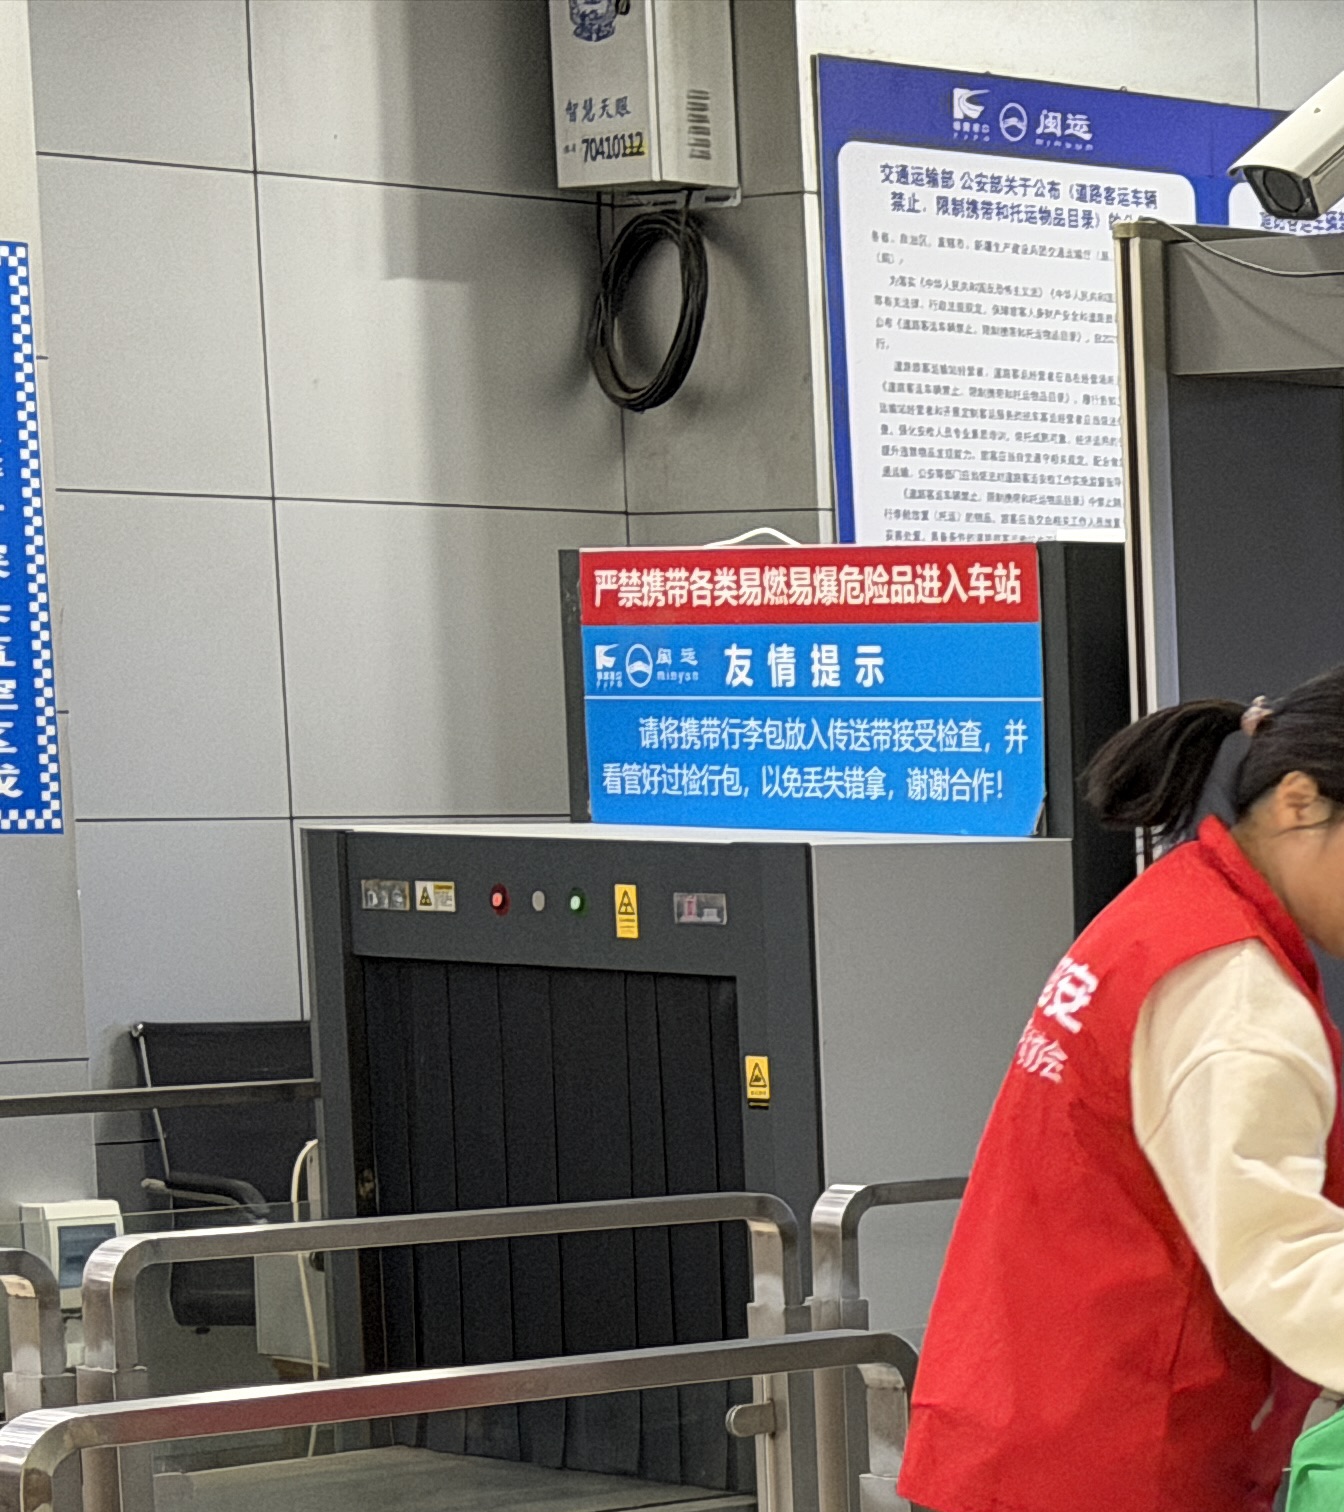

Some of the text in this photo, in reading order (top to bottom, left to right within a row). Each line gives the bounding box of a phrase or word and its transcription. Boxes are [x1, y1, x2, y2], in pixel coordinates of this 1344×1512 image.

[880, 163, 953, 189] 交通运输部
[594, 562, 1022, 608] 严禁携带各类易燃易爆危险品进入车站
[724, 643, 885, 688] 友情提示
